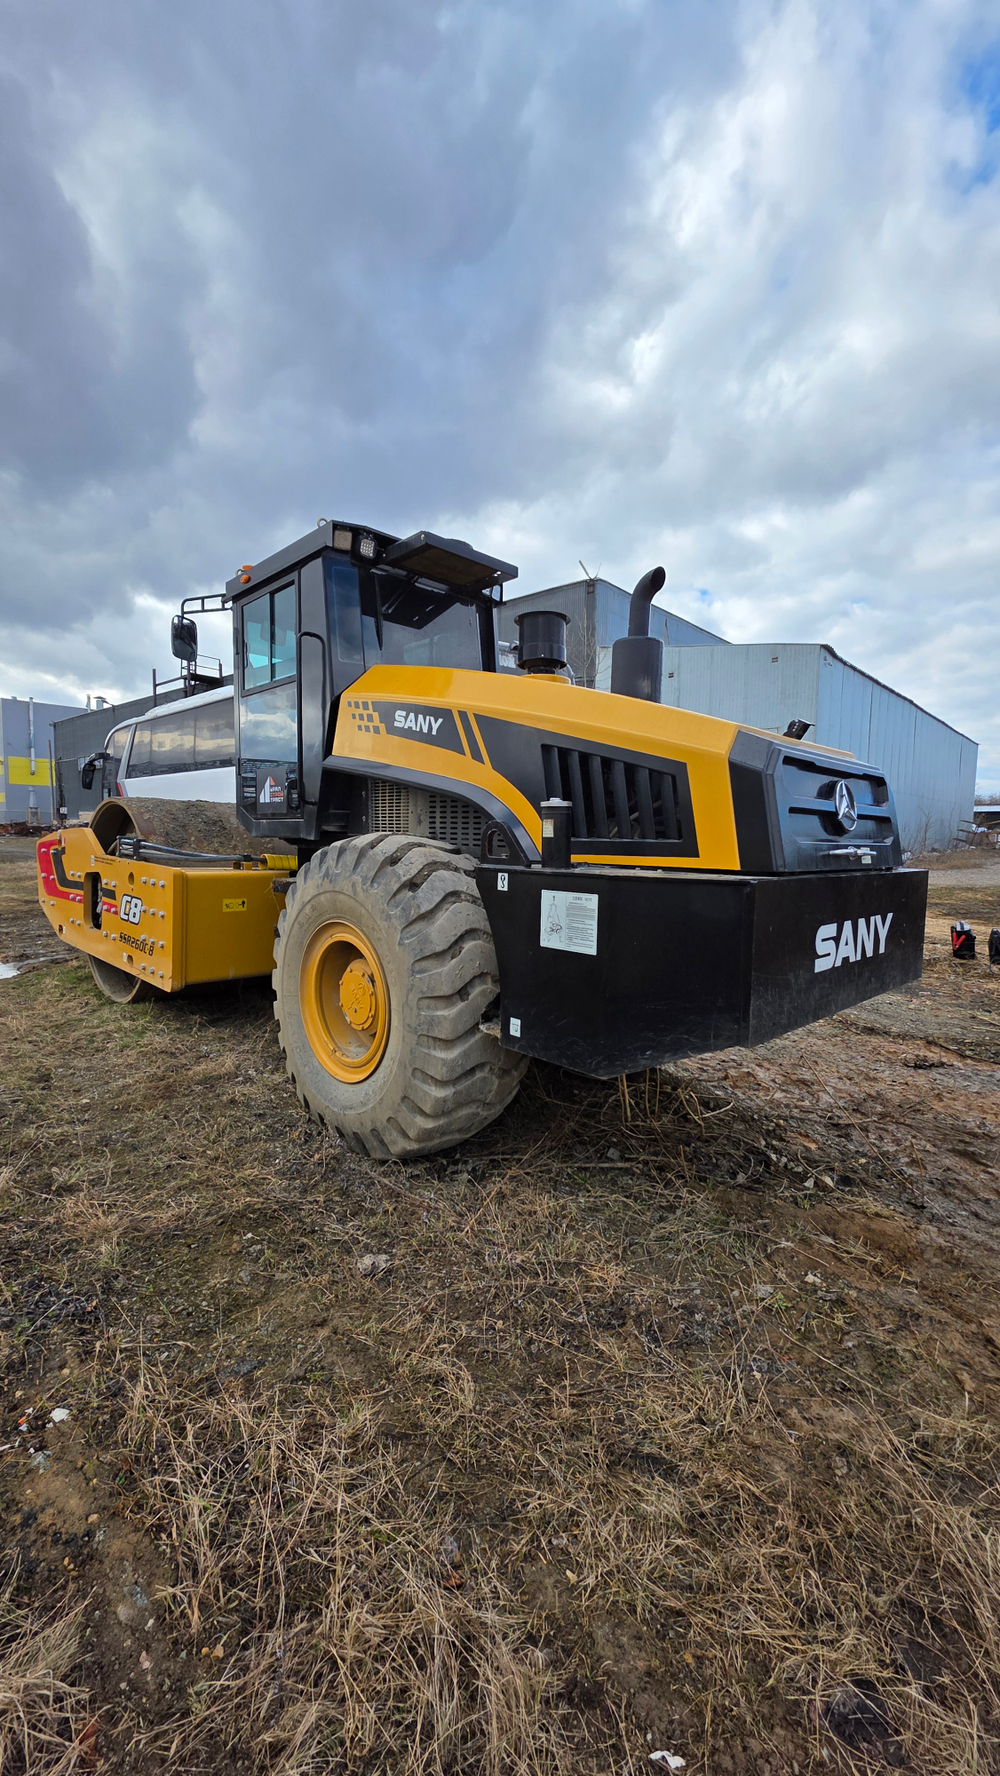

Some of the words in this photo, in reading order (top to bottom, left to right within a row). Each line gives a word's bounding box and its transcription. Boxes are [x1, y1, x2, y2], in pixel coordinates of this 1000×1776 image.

[394, 710, 443, 735] SANY
[120, 893, 143, 925] C8
[118, 931, 155, 957] SSR260C-8
[814, 912, 894, 973] SANY
